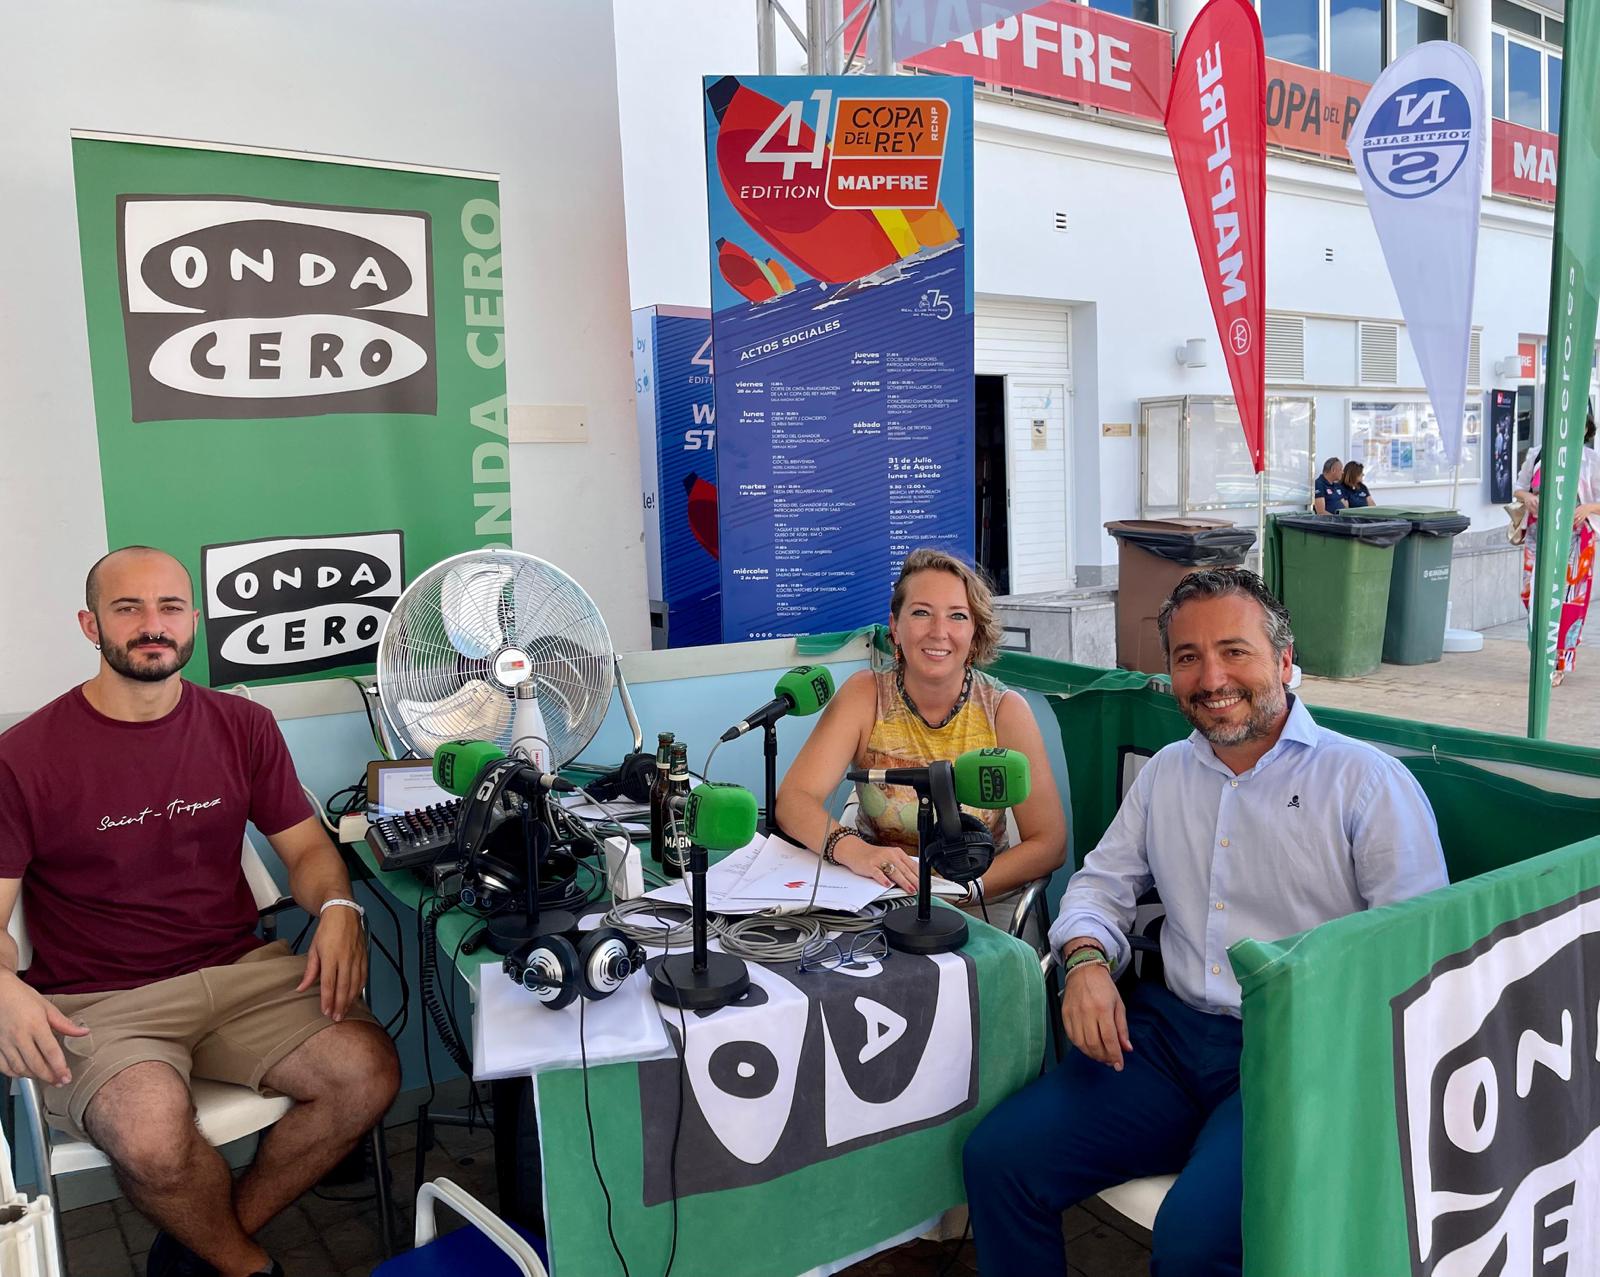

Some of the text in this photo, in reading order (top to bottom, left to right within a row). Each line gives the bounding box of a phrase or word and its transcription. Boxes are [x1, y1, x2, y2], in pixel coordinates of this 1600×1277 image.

[852, 106, 924, 129] COPA
[930, 106, 939, 142] RCNP
[1323, 107, 1340, 124] DEL
[844, 132, 924, 153] DEL REY
[740, 185, 820, 200] EDITION
[838, 174, 928, 190] MAPFRE
[170, 246, 388, 292] ONDA
[190, 330, 393, 380] CERO
[741, 320, 840, 361] ACTOS SOCIALES
[460, 198, 513, 550] NDA CERO
[234, 563, 376, 598] ONDA
[246, 615, 378, 656] CERO
[96, 807, 152, 831] Saint
[166, 797, 222, 820] Tropez
